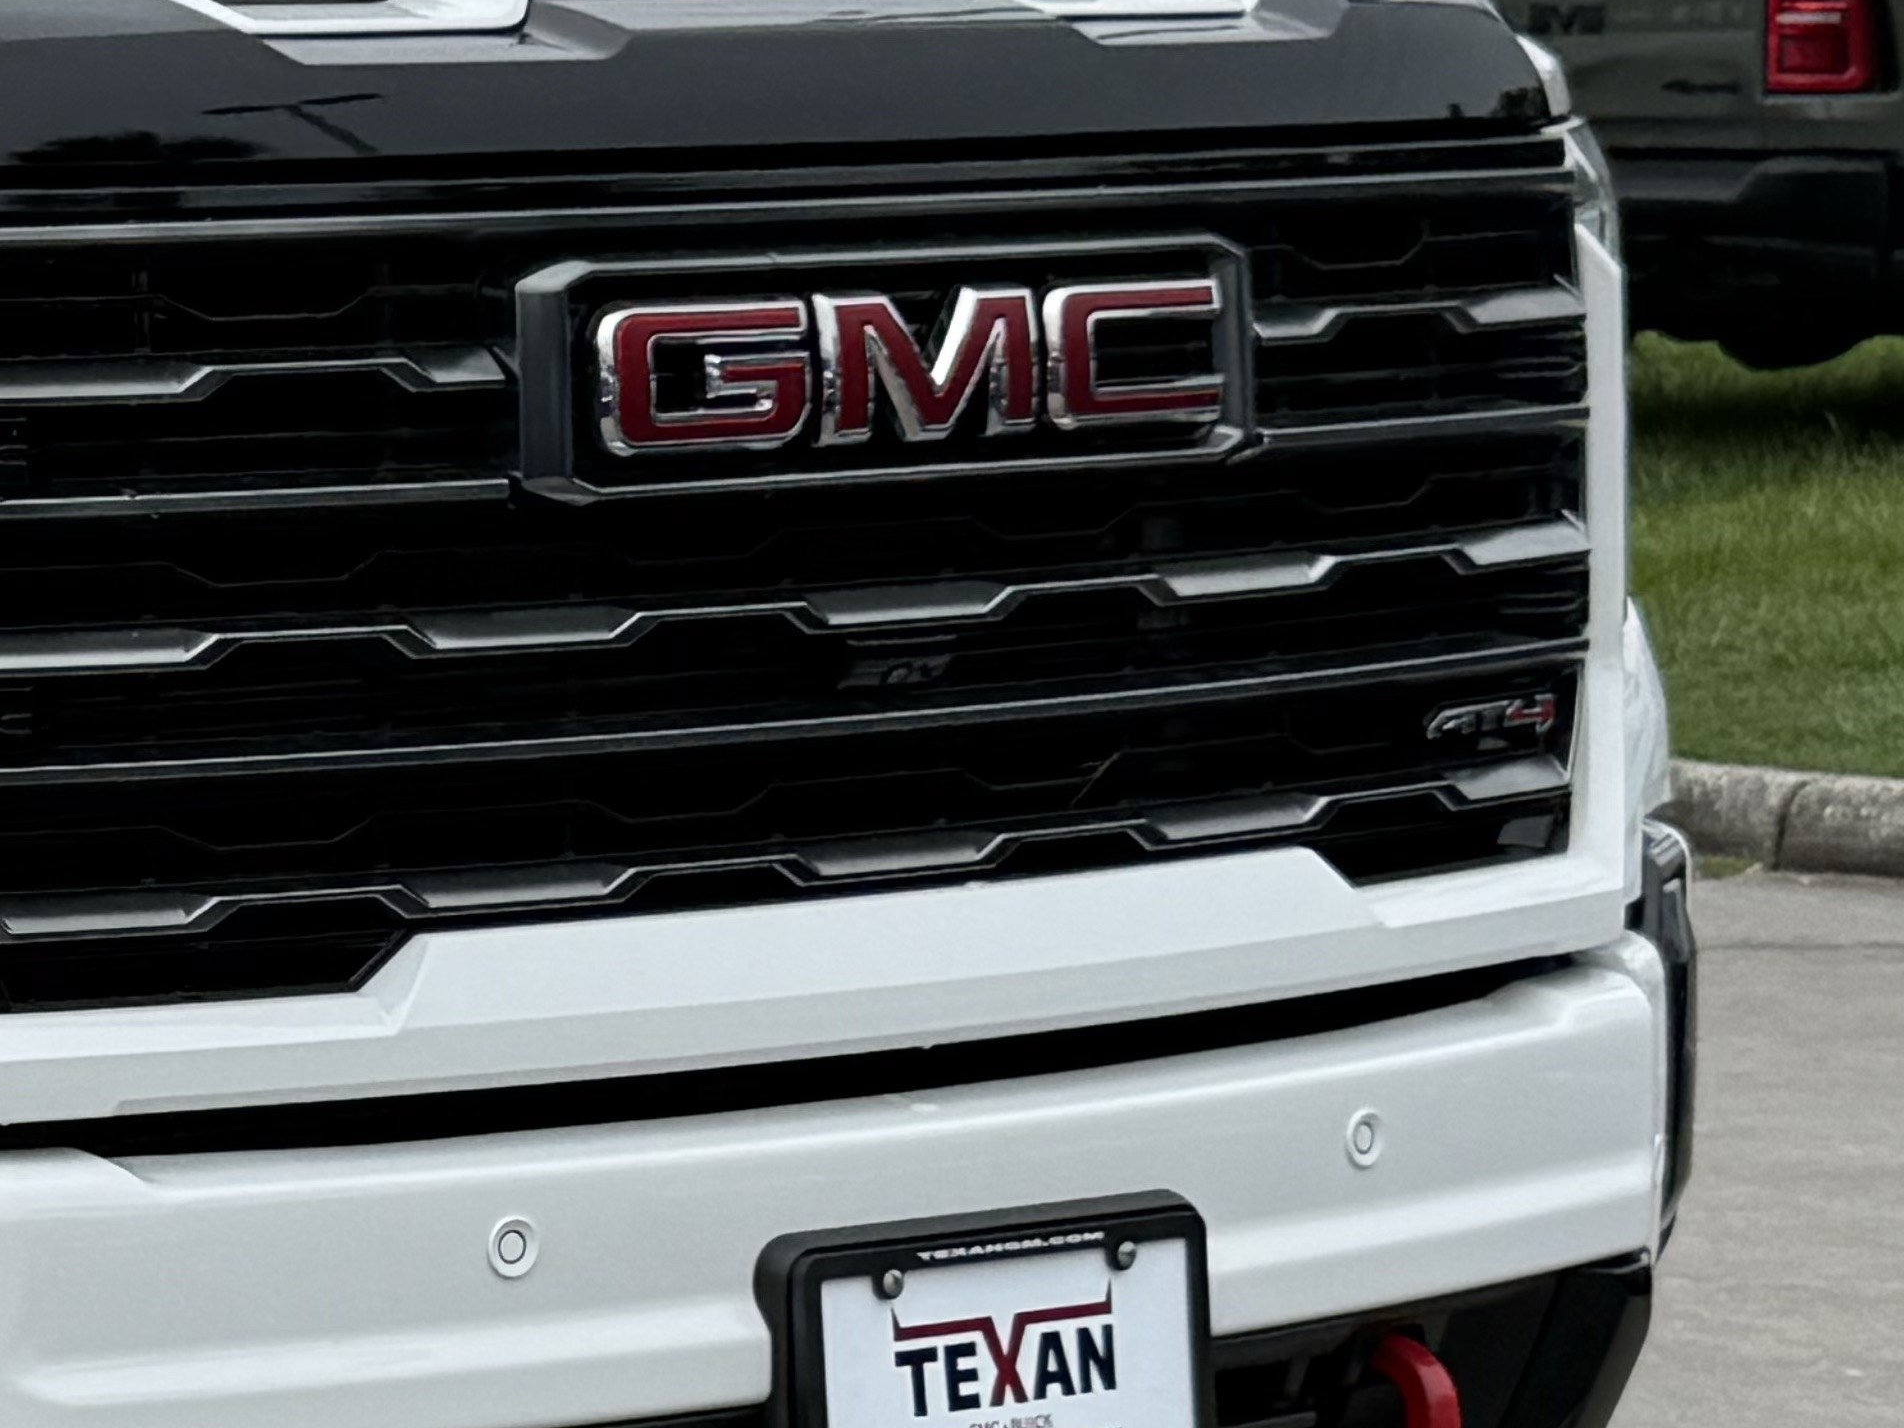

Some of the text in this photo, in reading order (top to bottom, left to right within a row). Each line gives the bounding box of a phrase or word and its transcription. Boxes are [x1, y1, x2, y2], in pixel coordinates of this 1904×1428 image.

[595, 277, 1222, 457] GMC
[1426, 694, 1556, 739] AT4
[894, 1314, 1117, 1417] TEXAN
